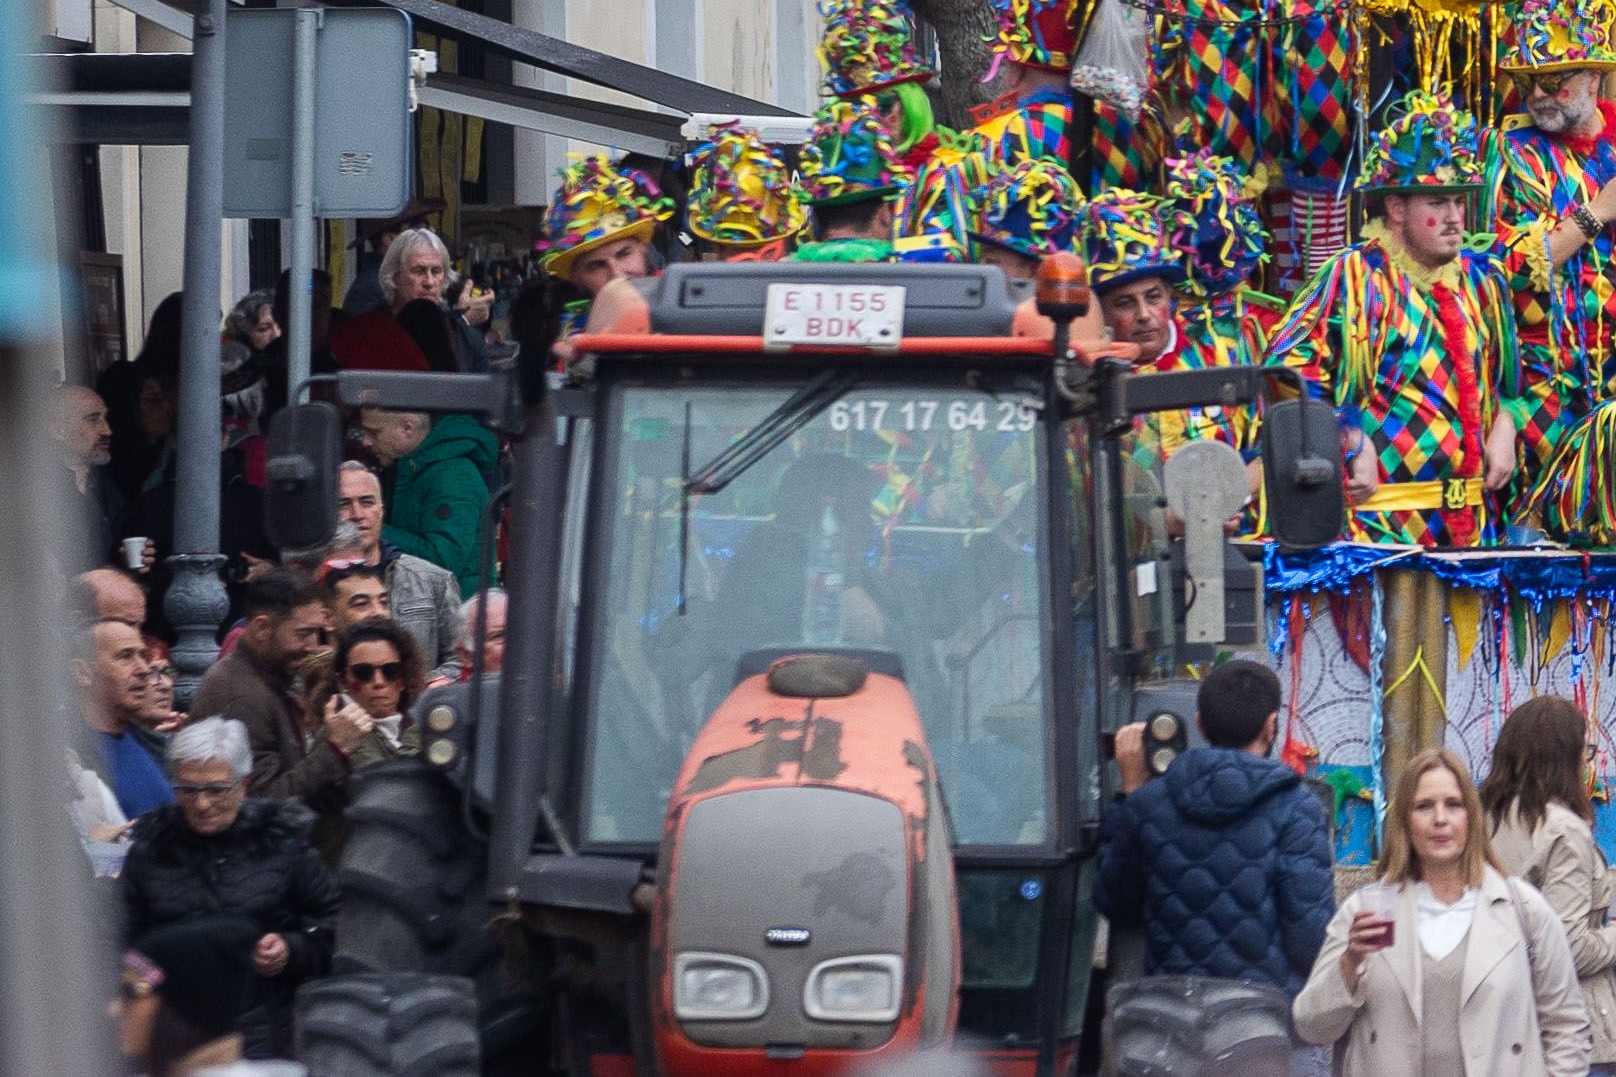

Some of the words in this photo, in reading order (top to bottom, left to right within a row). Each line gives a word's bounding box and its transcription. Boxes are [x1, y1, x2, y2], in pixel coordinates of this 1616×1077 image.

[784, 291, 799, 310] E
[815, 292, 886, 311] 1155
[806, 318, 863, 337] BDK
[830, 401, 889, 431] 617
[901, 401, 938, 430] 17
[948, 401, 988, 430] 64
